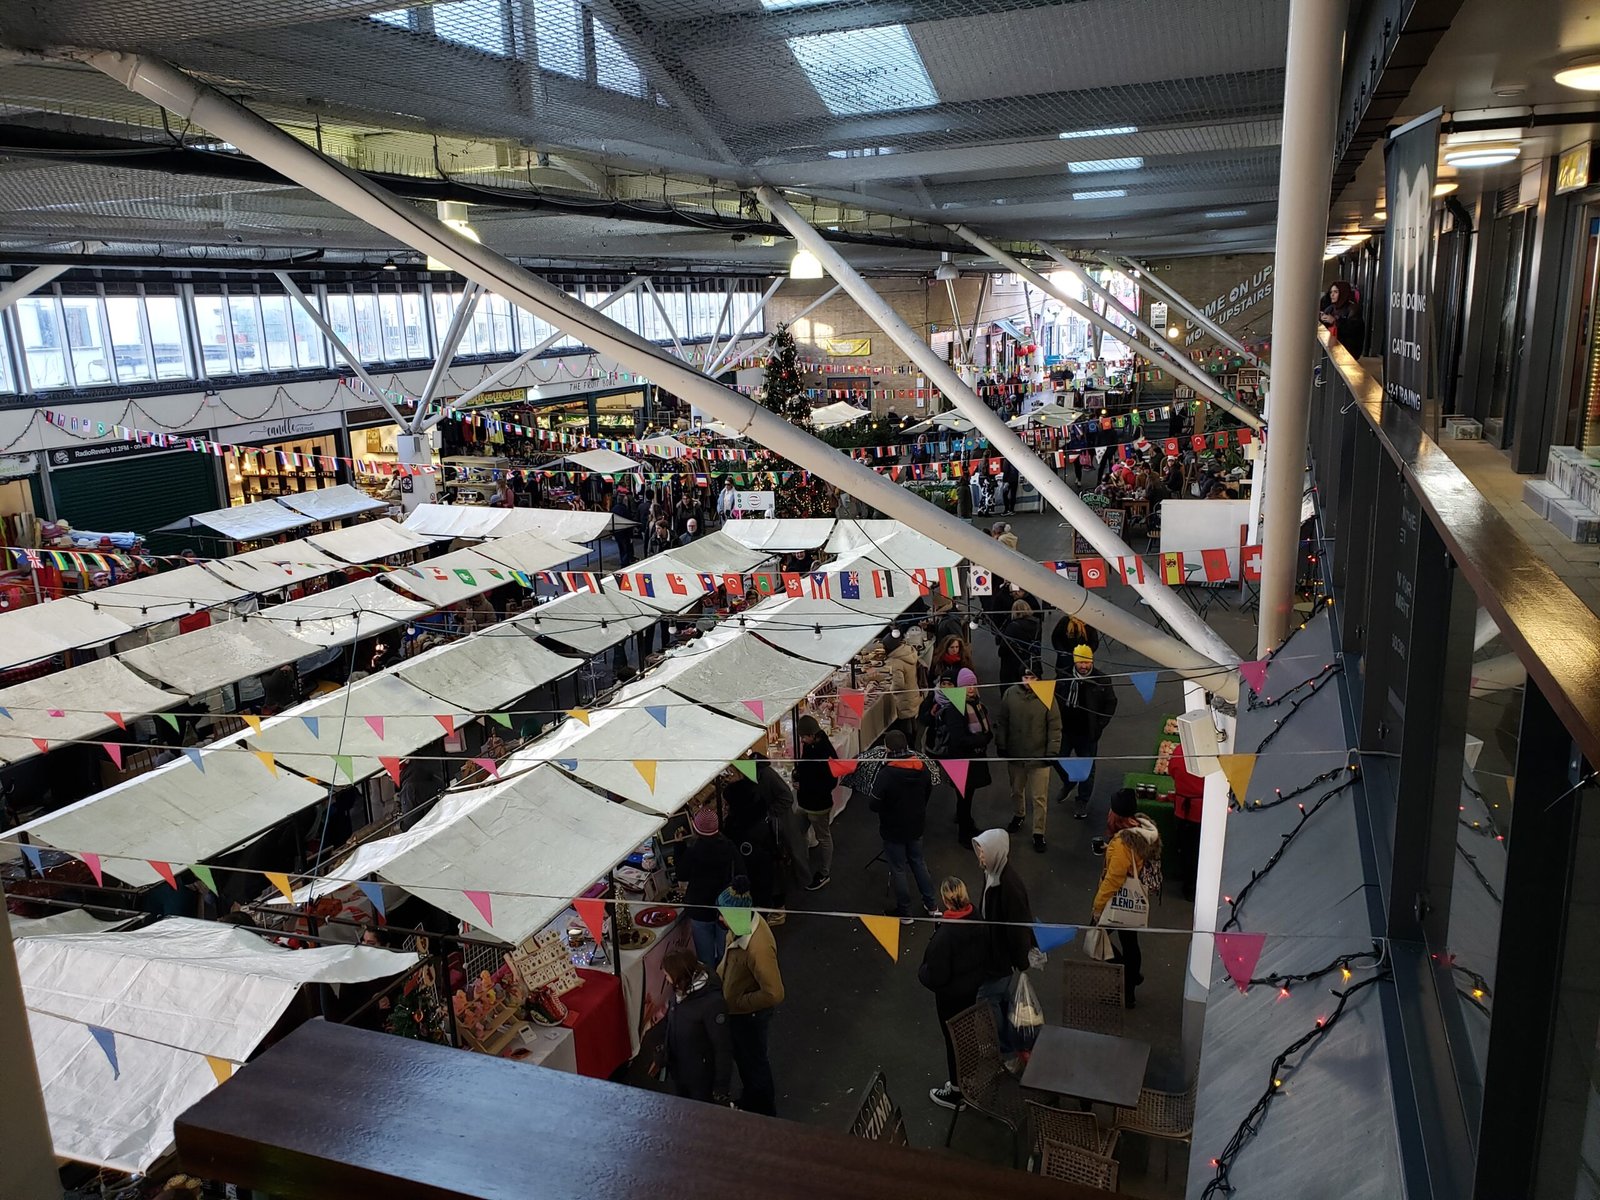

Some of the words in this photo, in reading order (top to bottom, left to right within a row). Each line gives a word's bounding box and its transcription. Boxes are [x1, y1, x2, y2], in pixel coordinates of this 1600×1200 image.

[1229, 280, 1249, 302] ON
[1253, 265, 1273, 287] UP
[1219, 284, 1272, 324] UPSTAIRS
[569, 382, 581, 391] THE
[583, 381, 600, 390] FRUIT
[267, 418, 297, 437] candle
[75, 447, 110, 458] RadioReverb
